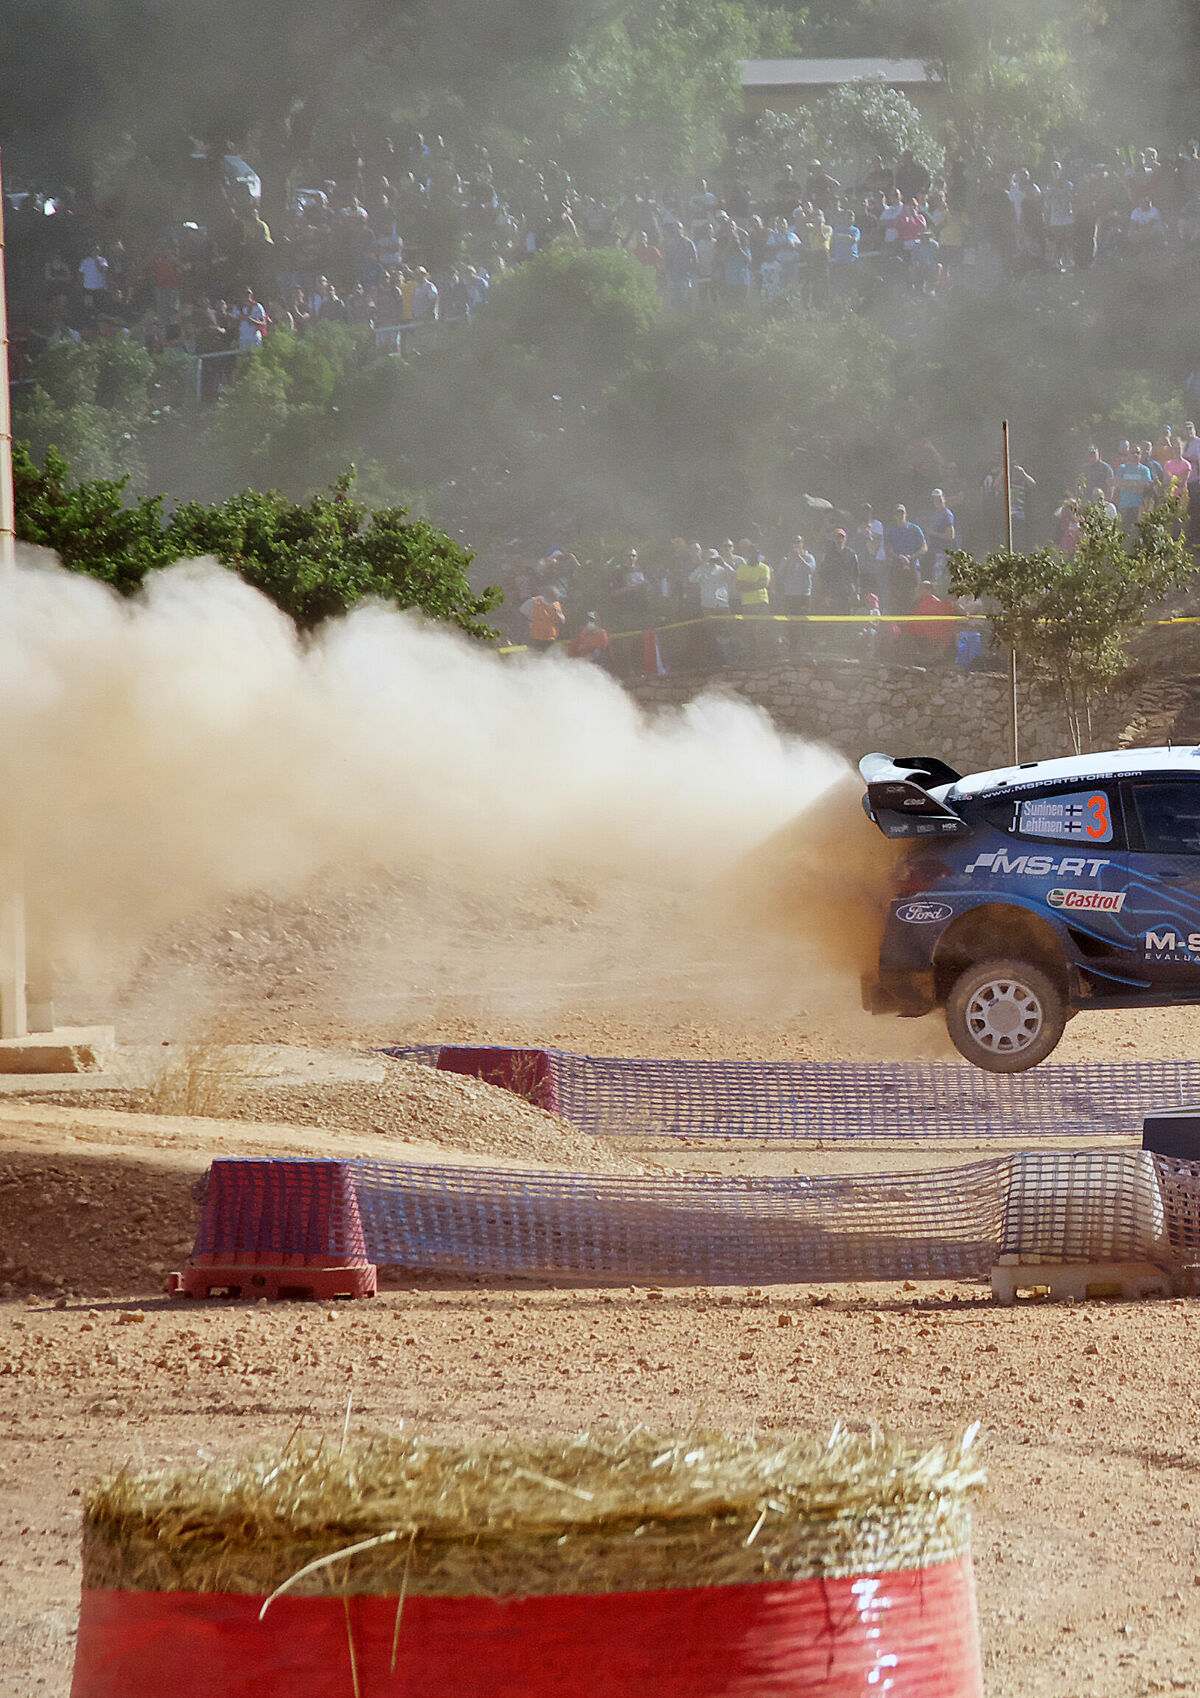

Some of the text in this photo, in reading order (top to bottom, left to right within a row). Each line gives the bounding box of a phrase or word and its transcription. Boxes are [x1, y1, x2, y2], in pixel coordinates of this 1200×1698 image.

[982, 771, 1143, 799] www.MSPORTSTORE.com
[1014, 801, 1063, 816] T Suninen
[1087, 796, 1108, 838] 3
[1008, 817, 1062, 833] J Lehtinen
[991, 854, 1110, 877] MS-RT
[1065, 891, 1120, 910] Castrol
[905, 904, 943, 920] Ford
